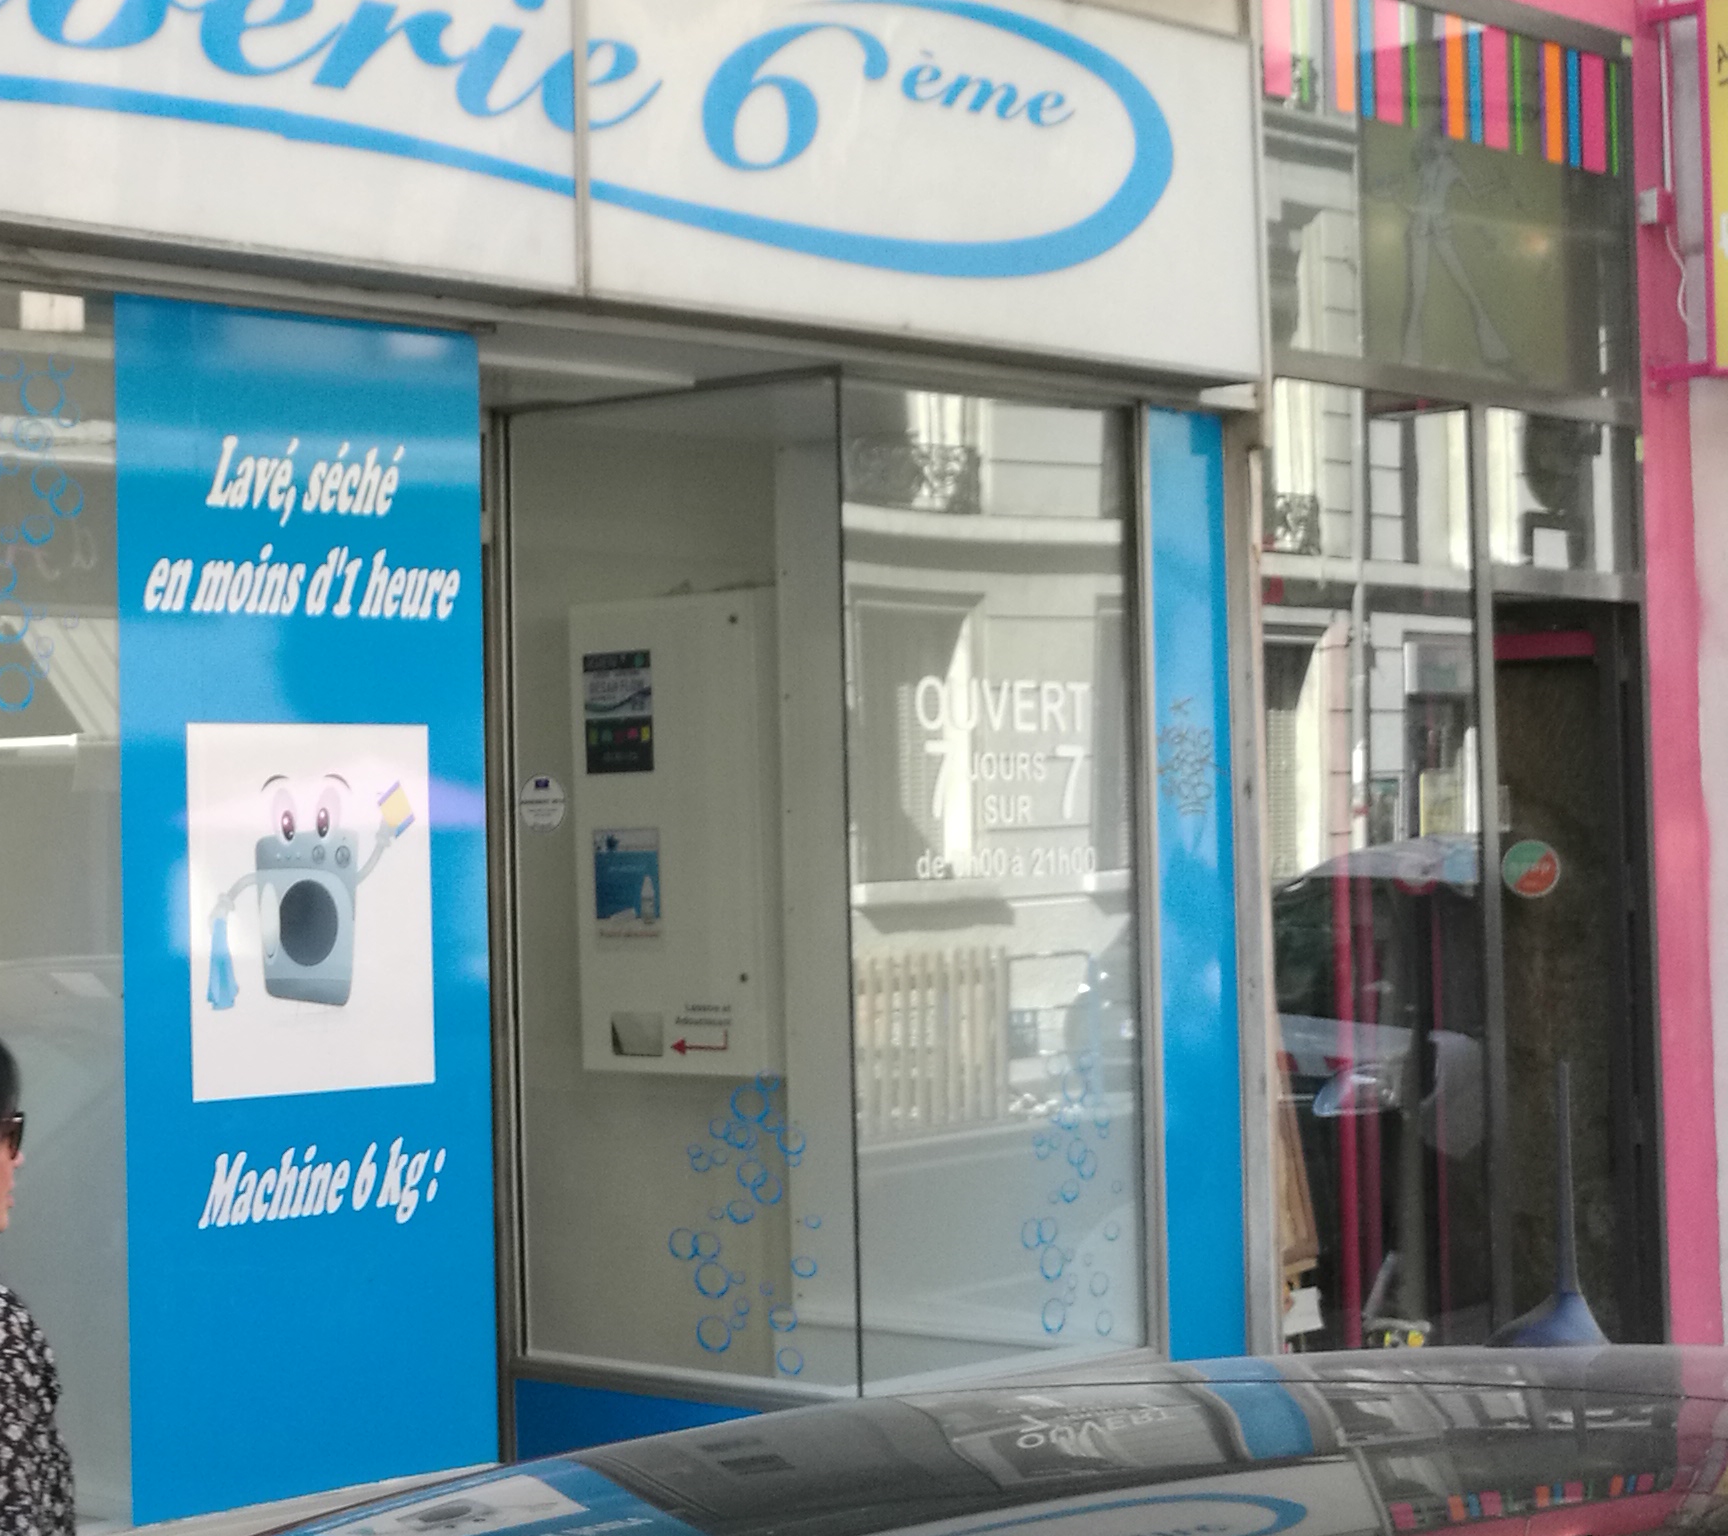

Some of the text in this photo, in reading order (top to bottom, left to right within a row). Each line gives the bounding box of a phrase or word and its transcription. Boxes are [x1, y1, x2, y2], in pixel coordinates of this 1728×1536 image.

[205, 434, 405, 527] Lavé, séché
[143, 556, 194, 613] en
[191, 543, 306, 616] moins
[358, 548, 461, 621] heure
[914, 675, 1094, 732] OUVERT
[970, 751, 1047, 782] JOURS
[1055, 744, 1086, 820] 7
[982, 794, 1034, 824] SUR
[197, 1144, 351, 1230] Machine
[352, 1141, 378, 1212] 6
